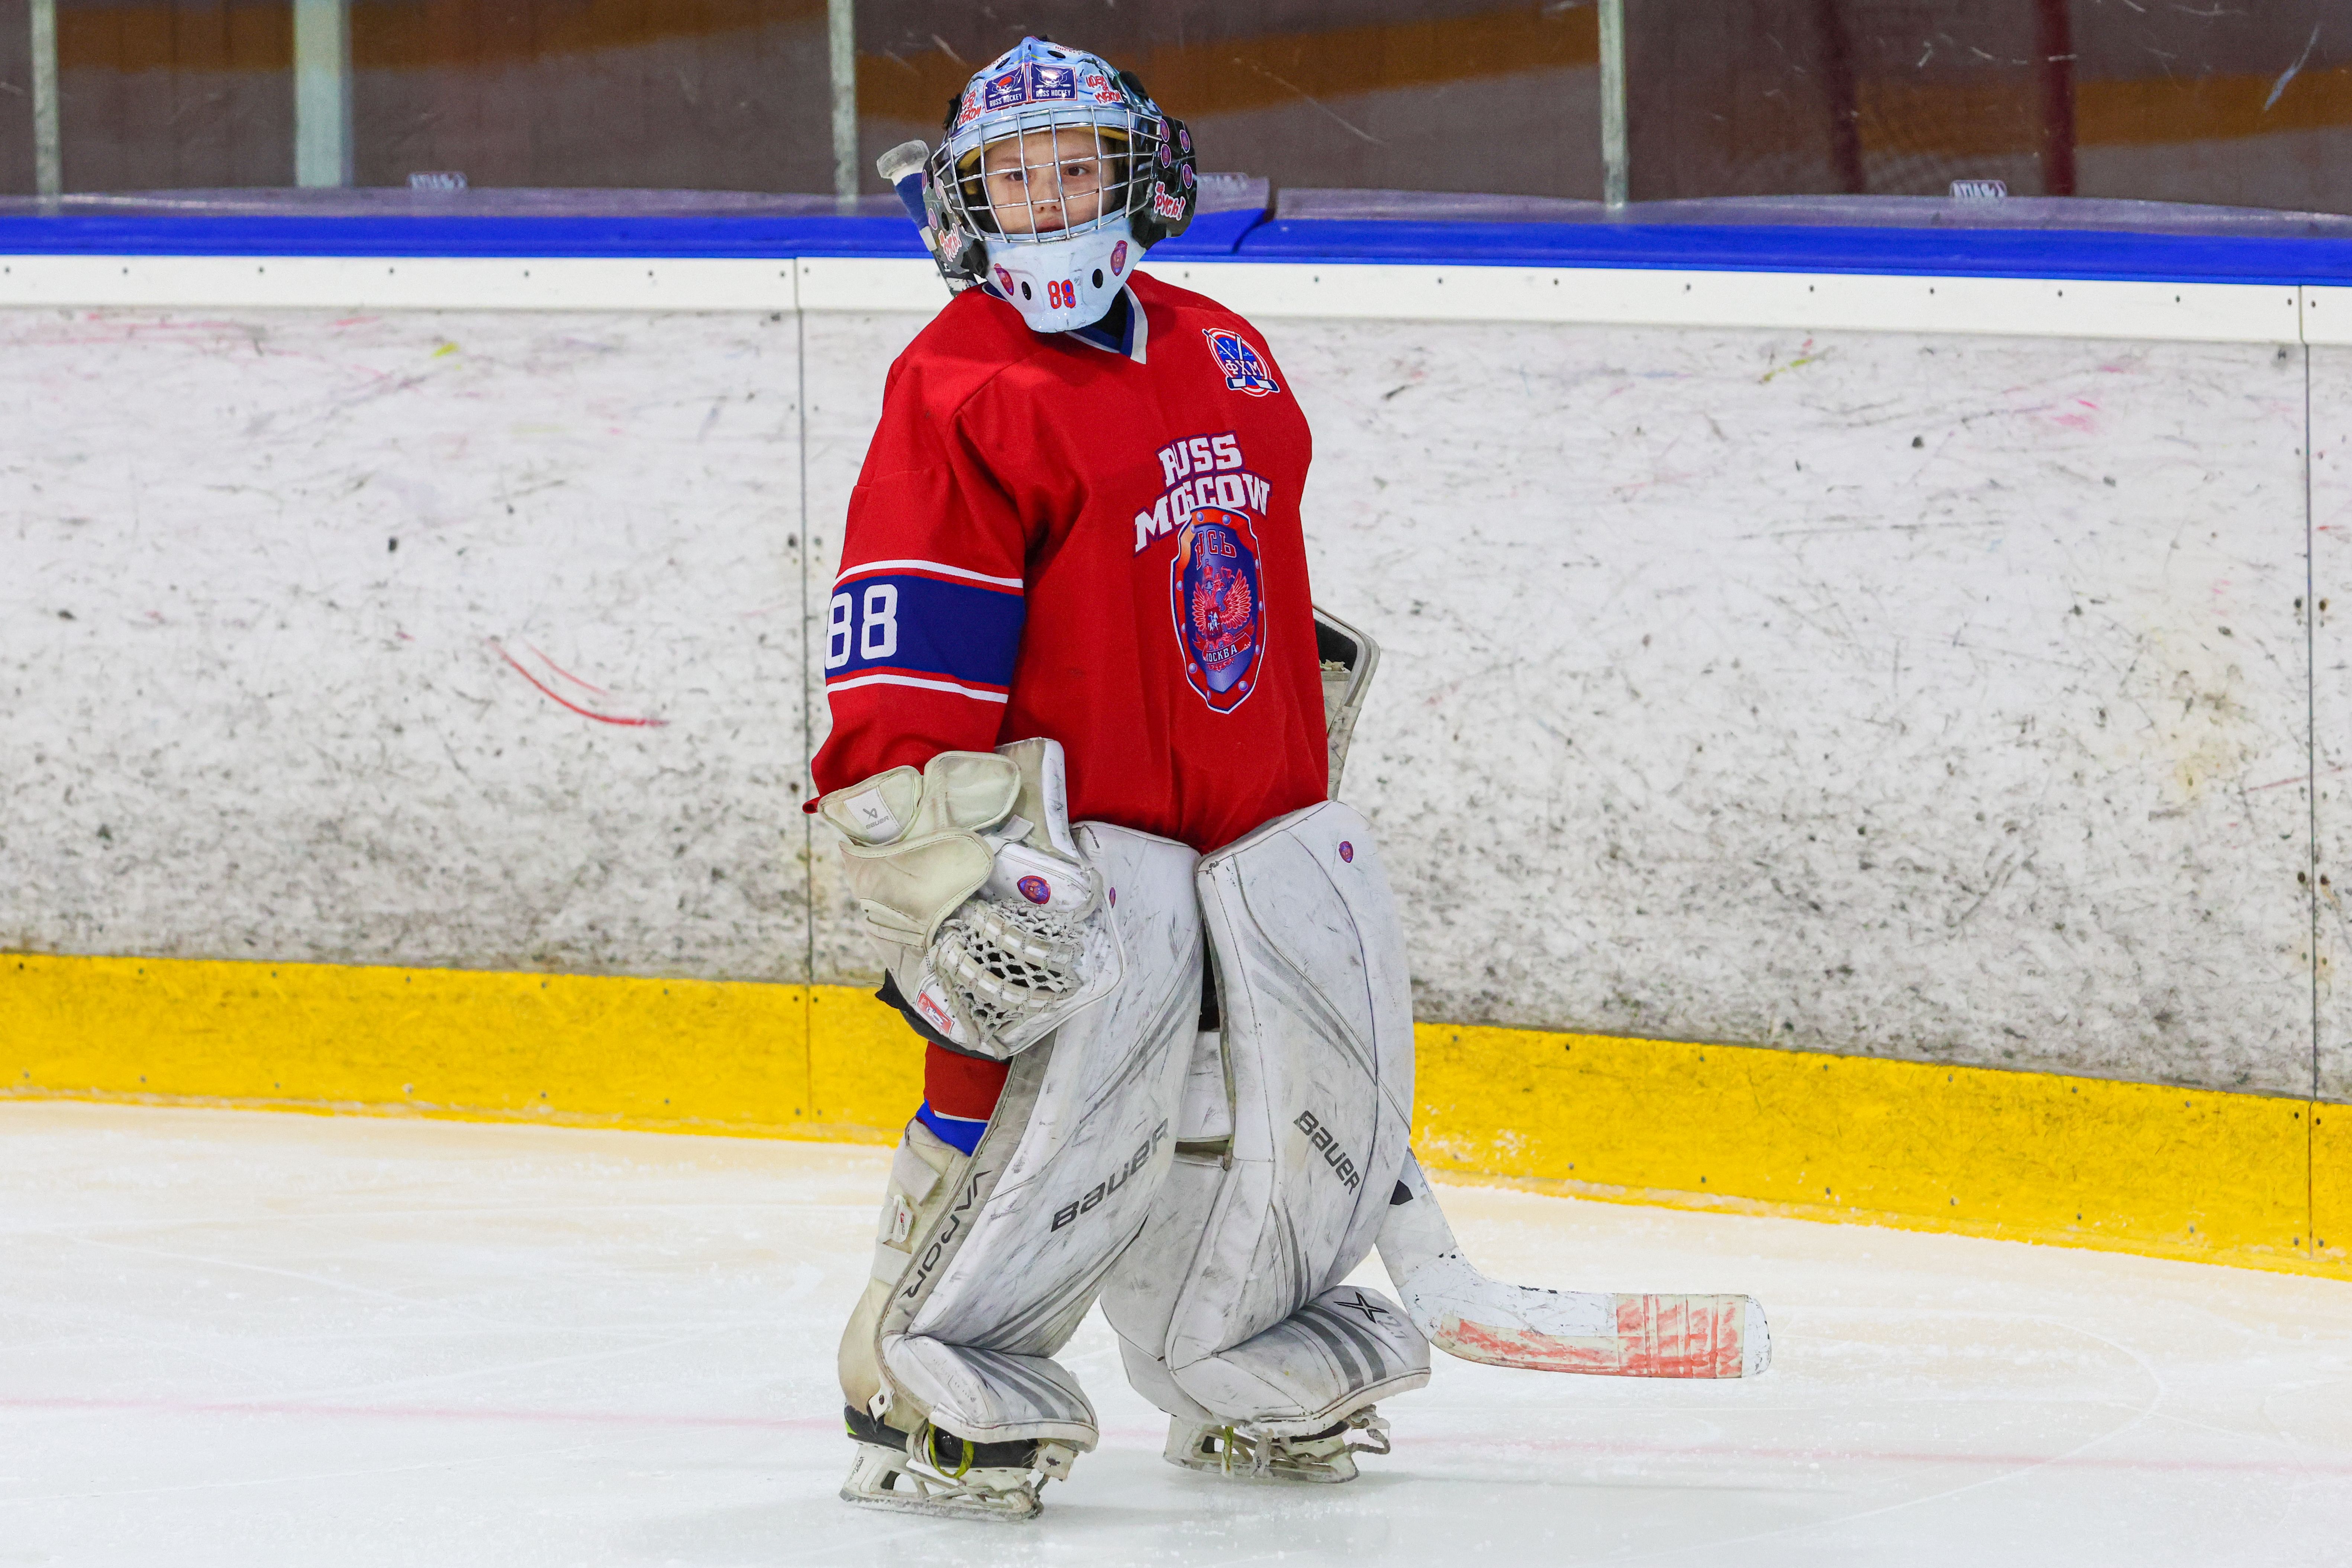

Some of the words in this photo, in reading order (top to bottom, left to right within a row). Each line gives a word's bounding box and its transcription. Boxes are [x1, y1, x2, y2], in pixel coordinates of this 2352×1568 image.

[989, 98, 1002, 107] RUSS
[1003, 93, 1022, 103] HOCKEY
[1048, 279, 1076, 309] 88
[1225, 359, 1264, 377] ФХМ
[1158, 434, 1242, 487] RUSS
[1135, 473, 1270, 553] MOSCOW
[825, 584, 898, 670] 88
[899, 1170, 993, 1299] VAPOR
